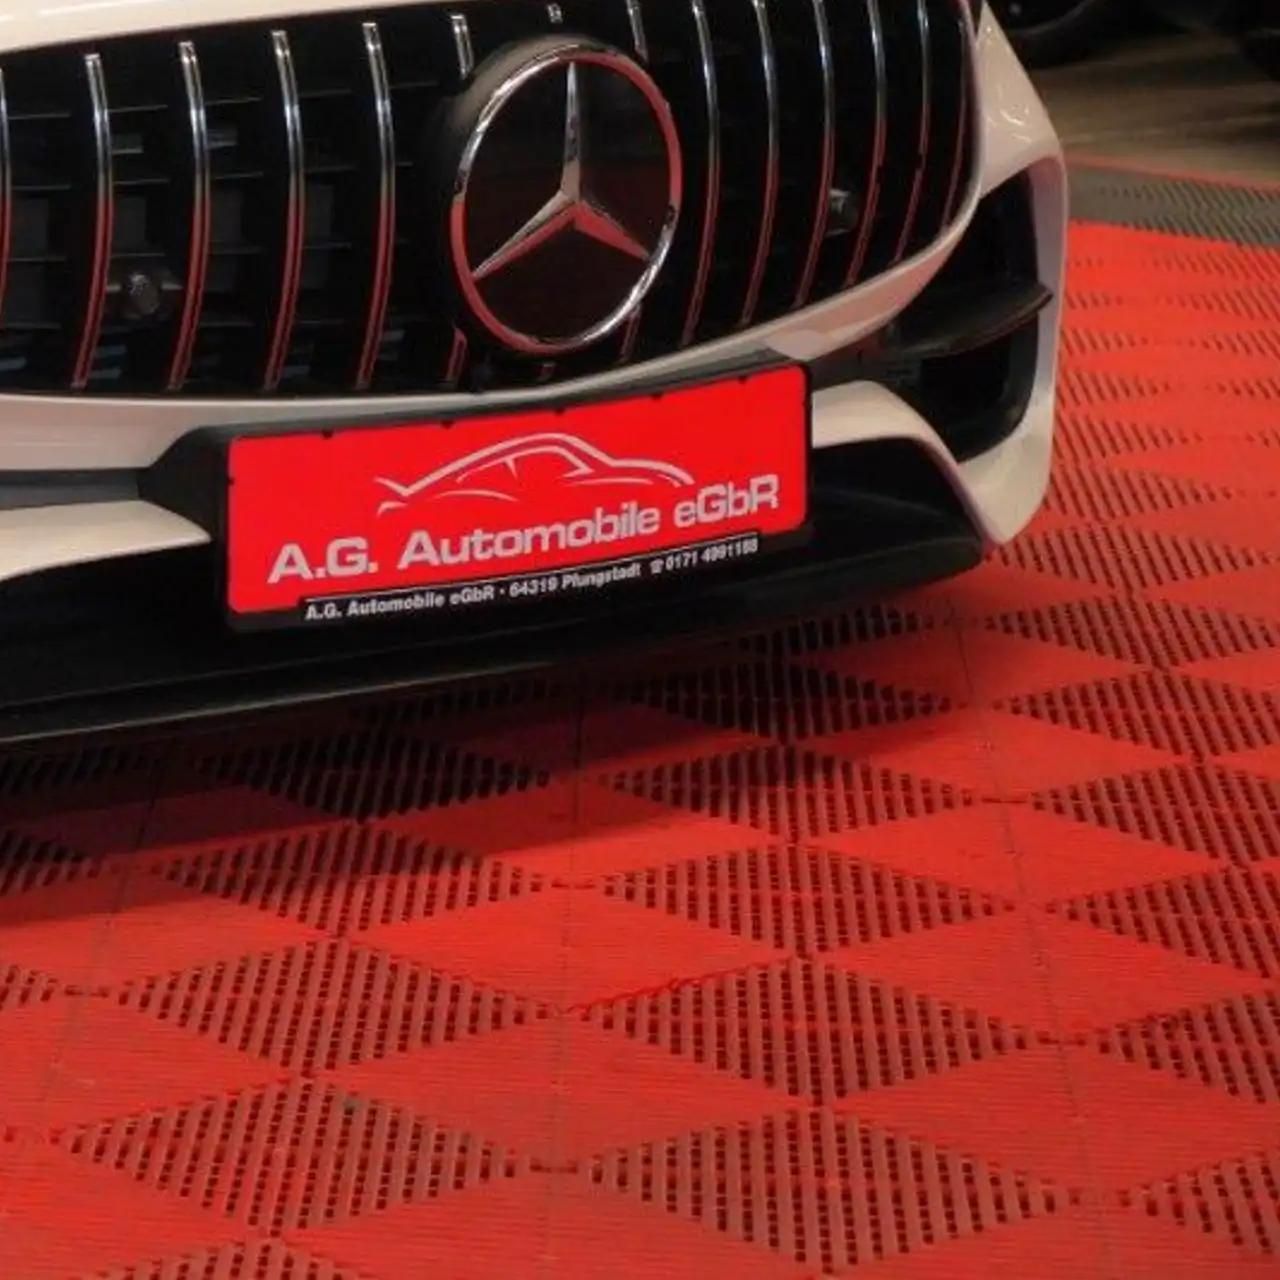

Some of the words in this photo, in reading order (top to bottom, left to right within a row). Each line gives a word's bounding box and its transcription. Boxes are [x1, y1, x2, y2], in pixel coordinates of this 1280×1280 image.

[267, 536, 379, 584] A.G.
[396, 500, 661, 570] Automobile
[673, 473, 780, 528] eGbR
[304, 602, 342, 621] A.G.
[347, 591, 445, 617] Automobile
[449, 583, 495, 606] eGbR
[509, 577, 559, 600] 64319
[665, 550, 699, 572] 0171
